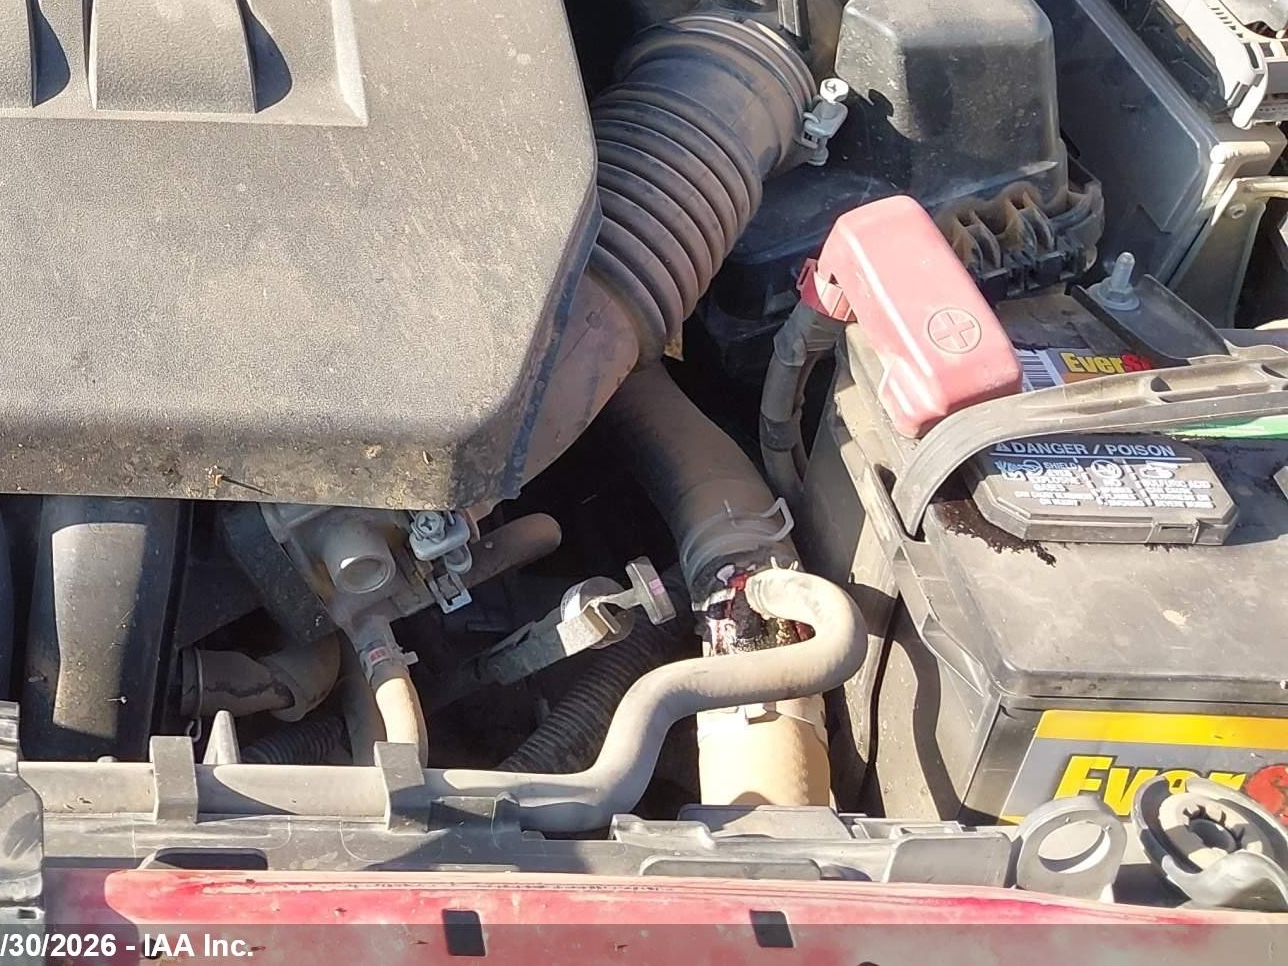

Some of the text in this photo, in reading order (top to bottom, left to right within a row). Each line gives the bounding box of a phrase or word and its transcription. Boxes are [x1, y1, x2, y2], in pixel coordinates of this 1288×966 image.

[1013, 442, 1176, 457] DANGER / POISON
